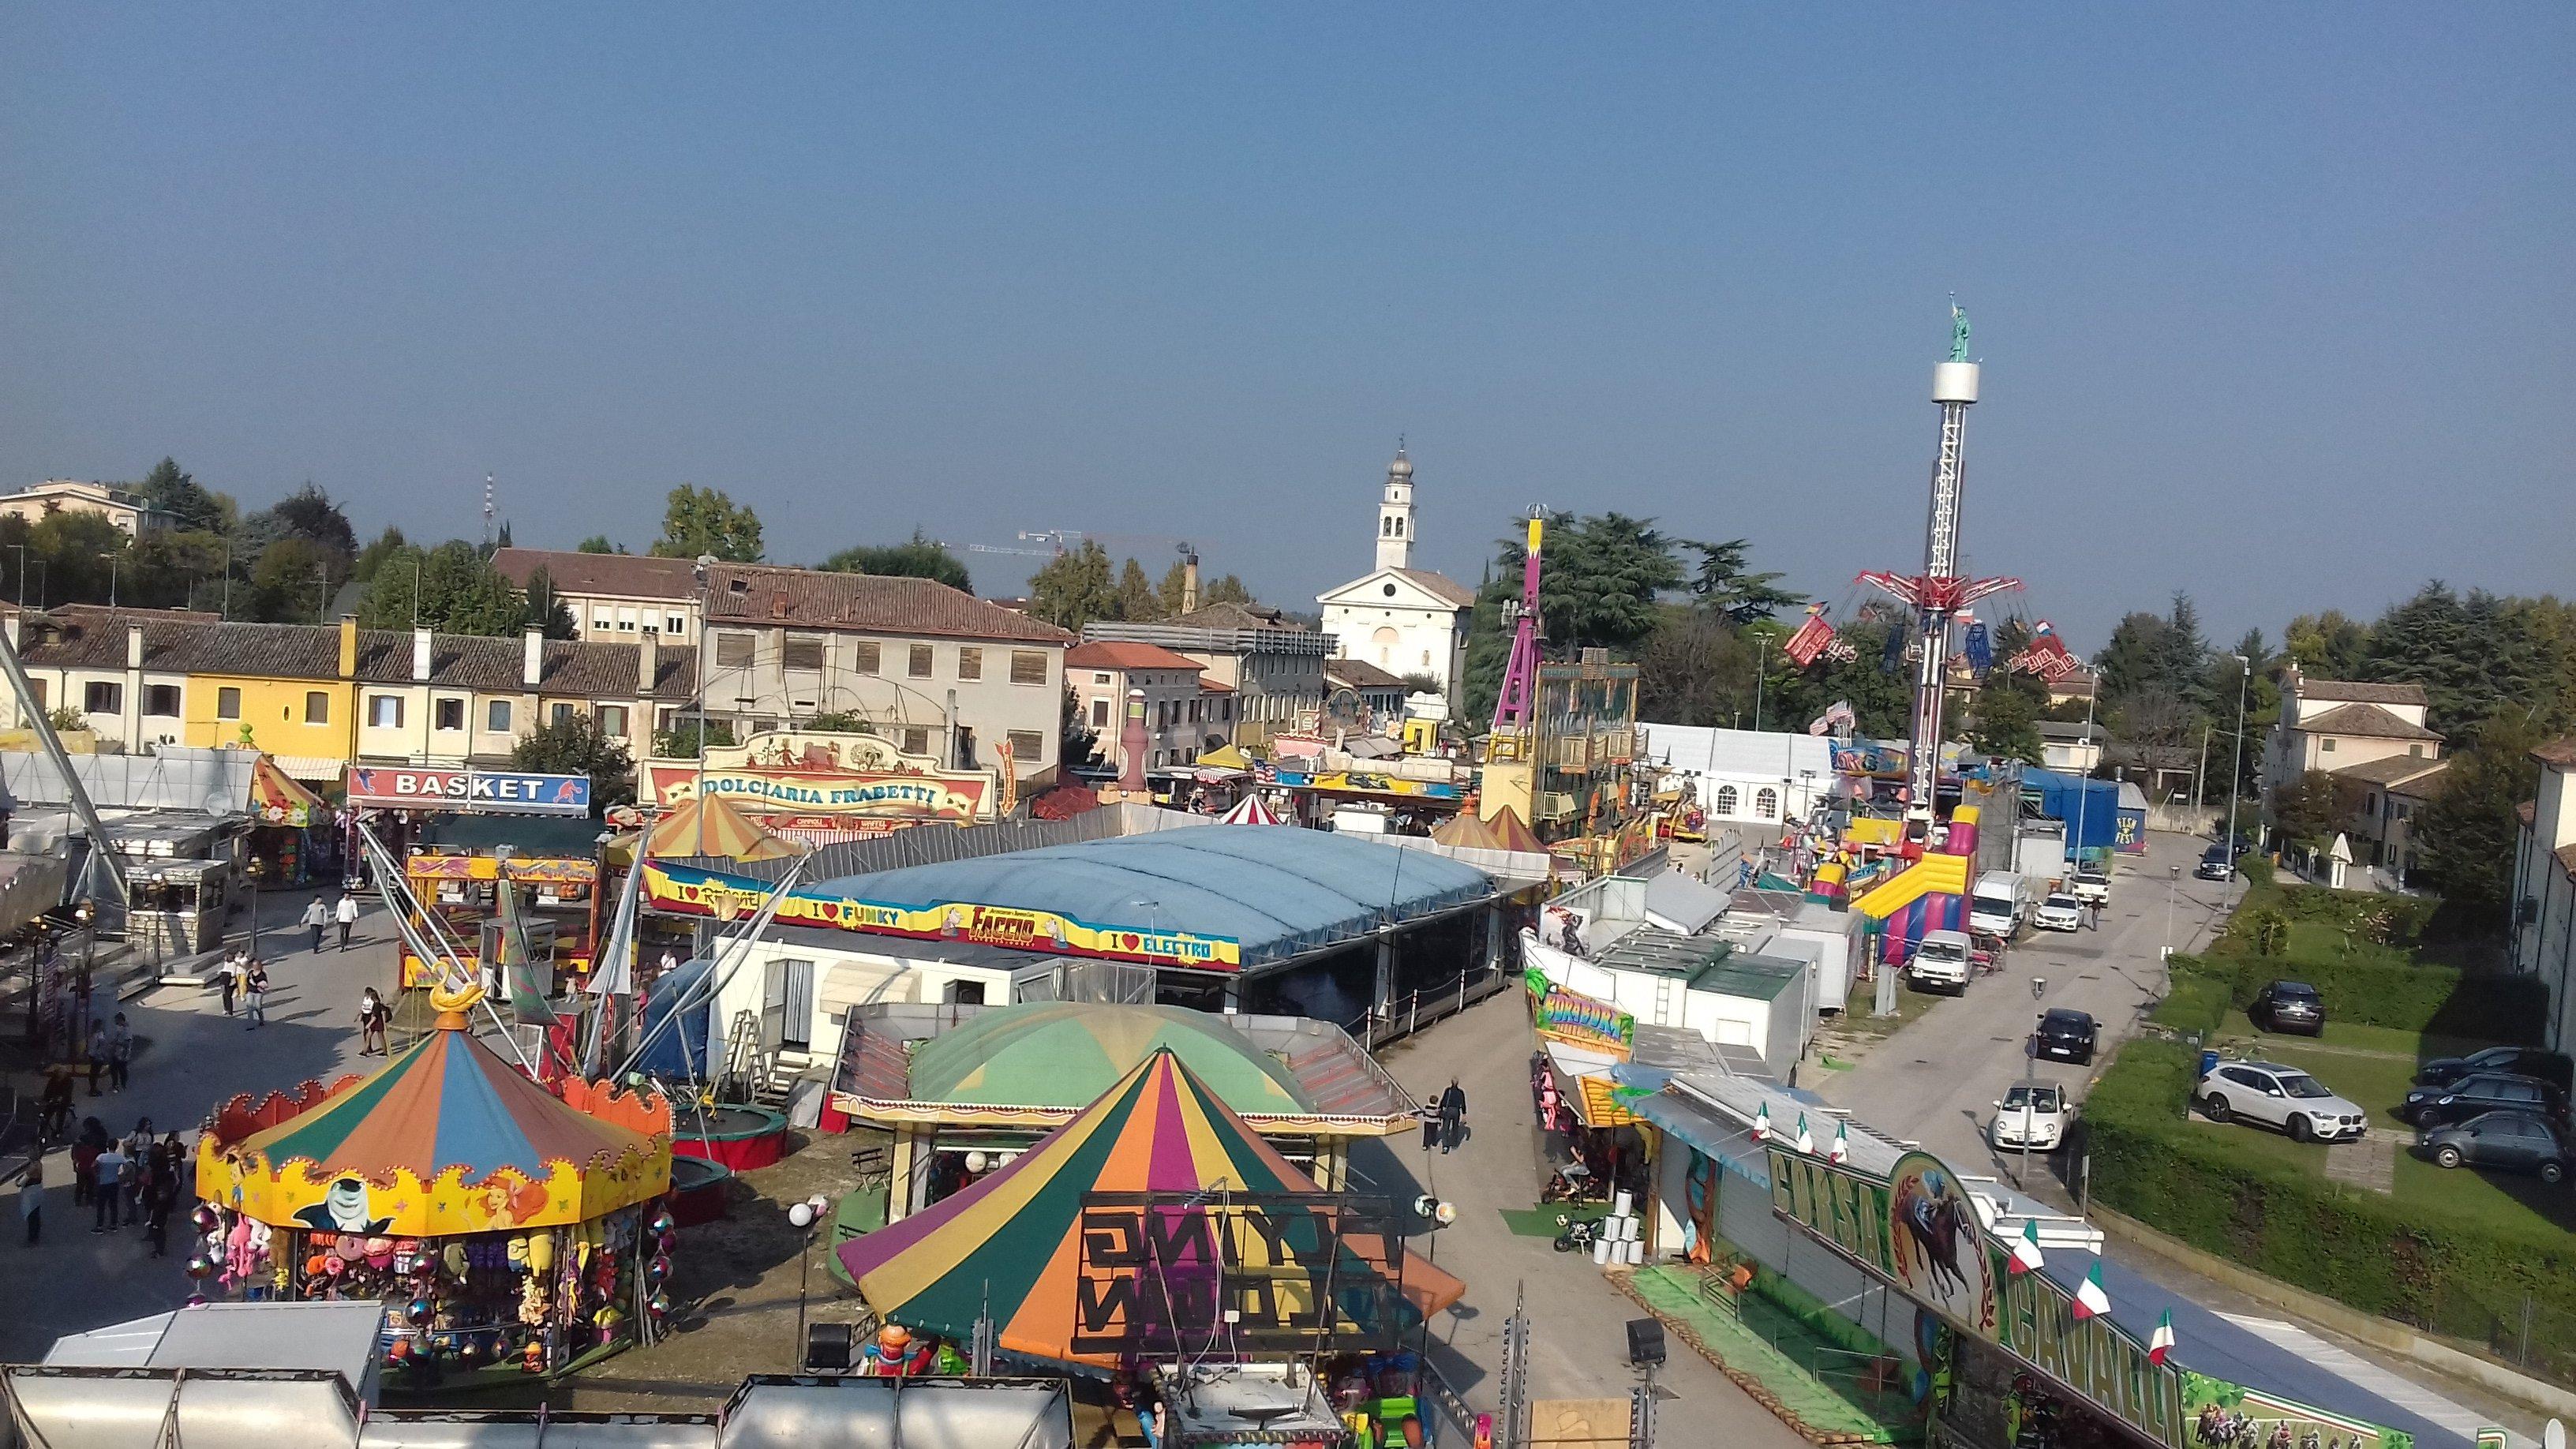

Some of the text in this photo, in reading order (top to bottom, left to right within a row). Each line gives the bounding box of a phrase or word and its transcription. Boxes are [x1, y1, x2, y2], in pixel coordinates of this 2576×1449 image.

[395, 774, 545, 800] BASKET
[702, 778, 937, 804] DOLCIARIA FRABETTI
[2116, 817, 2138, 830] FISH
[2114, 831, 2135, 844] FEST
[677, 885, 685, 900] I
[812, 902, 899, 927] I FUNKY
[969, 906, 1035, 942] FACCIO
[1110, 933, 1211, 958] I ELECTRO
[1769, 1151, 1884, 1271] CORSA
[2005, 1267, 2183, 1449] CAVALLI
